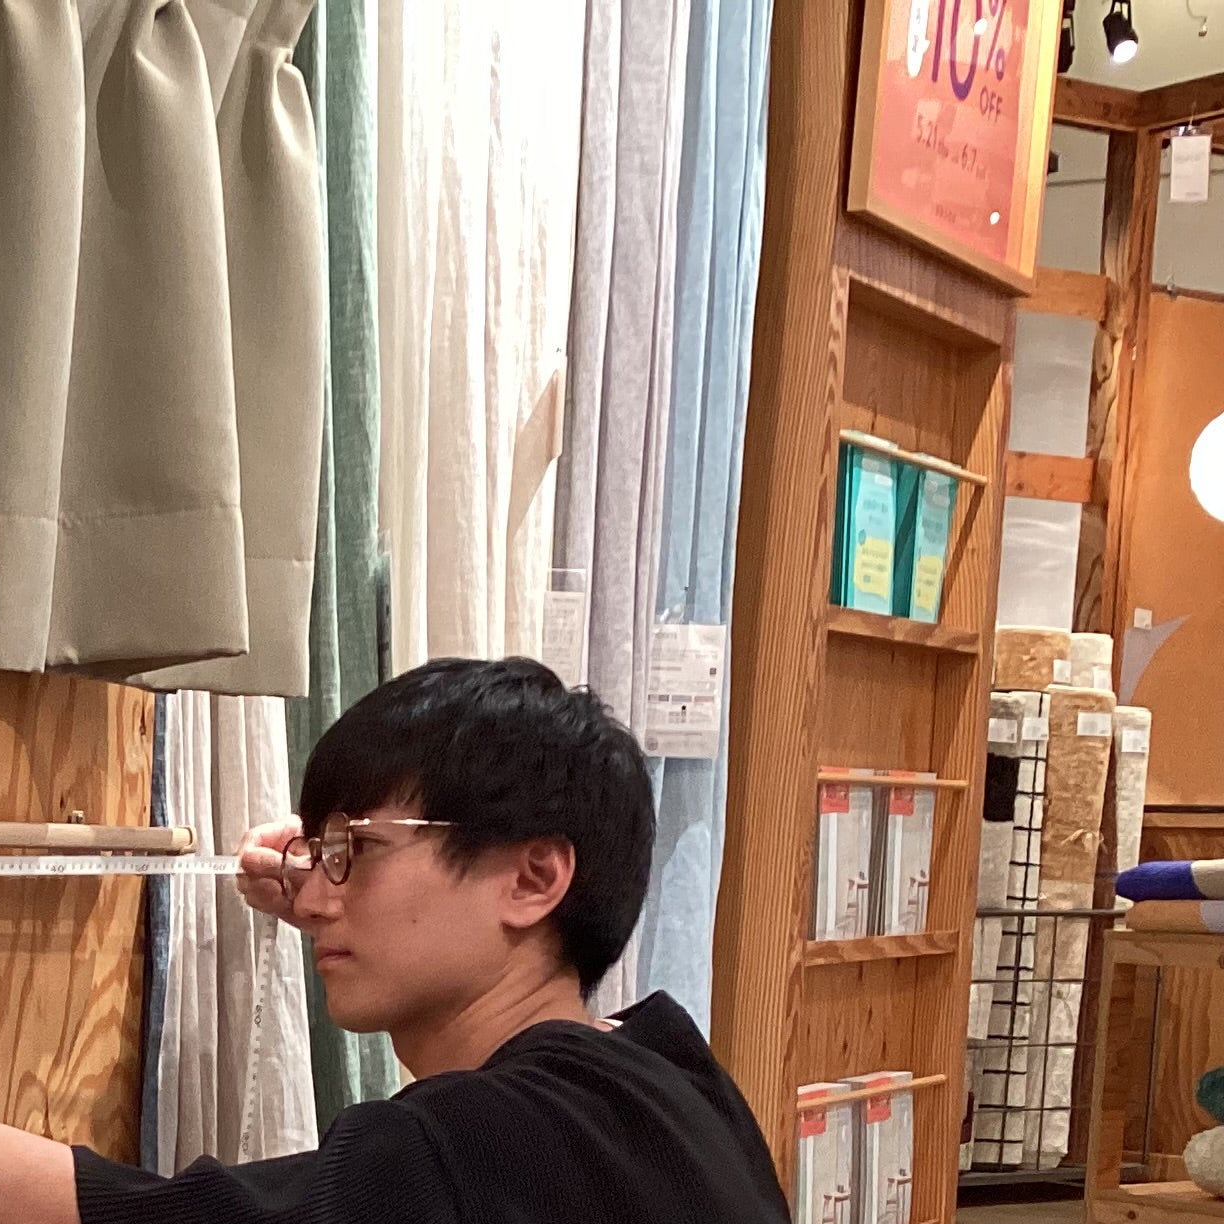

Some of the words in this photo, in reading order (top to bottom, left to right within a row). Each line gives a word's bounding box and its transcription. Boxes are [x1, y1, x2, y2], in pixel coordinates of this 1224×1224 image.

[932, 0, 1006, 101] 10%
[980, 85, 1003, 122] OFF
[50, 864, 65, 874] 40
